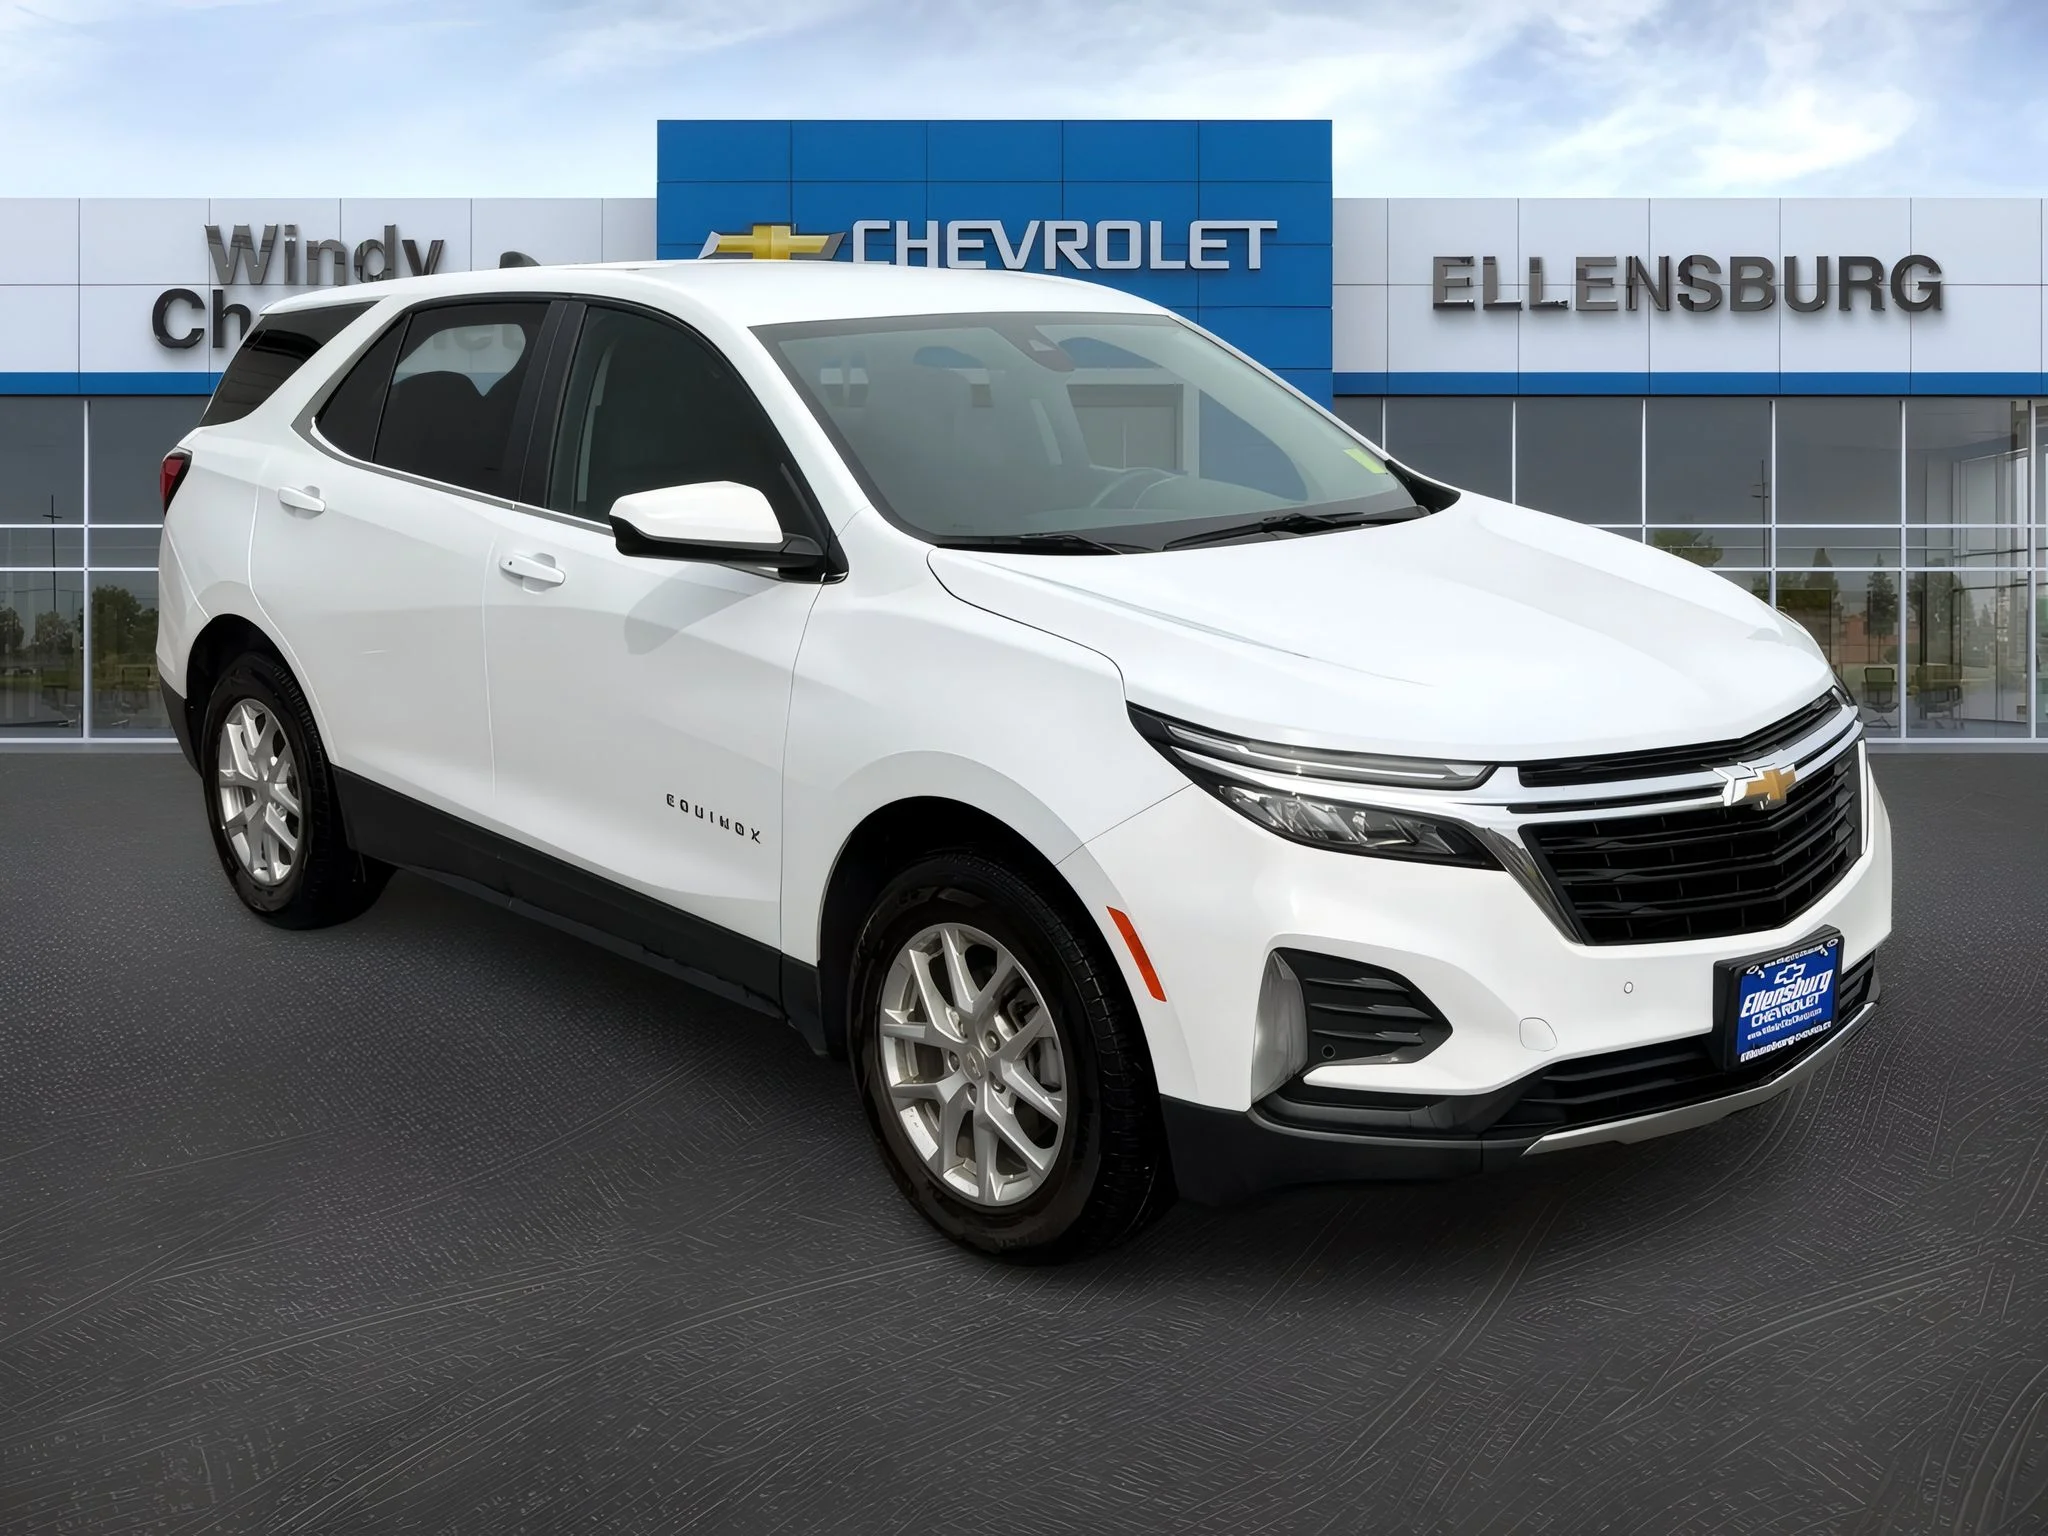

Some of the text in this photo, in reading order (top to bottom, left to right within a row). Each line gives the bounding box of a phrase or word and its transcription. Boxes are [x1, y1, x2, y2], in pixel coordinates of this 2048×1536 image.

[852, 220, 1278, 270] CHEVROLET
[1432, 254, 1943, 312] ELLENSBURG
[666, 793, 761, 844] EQUINOX
[1740, 969, 1834, 1018] Ellensburg
[1751, 993, 1820, 1027] CHEVROLET
